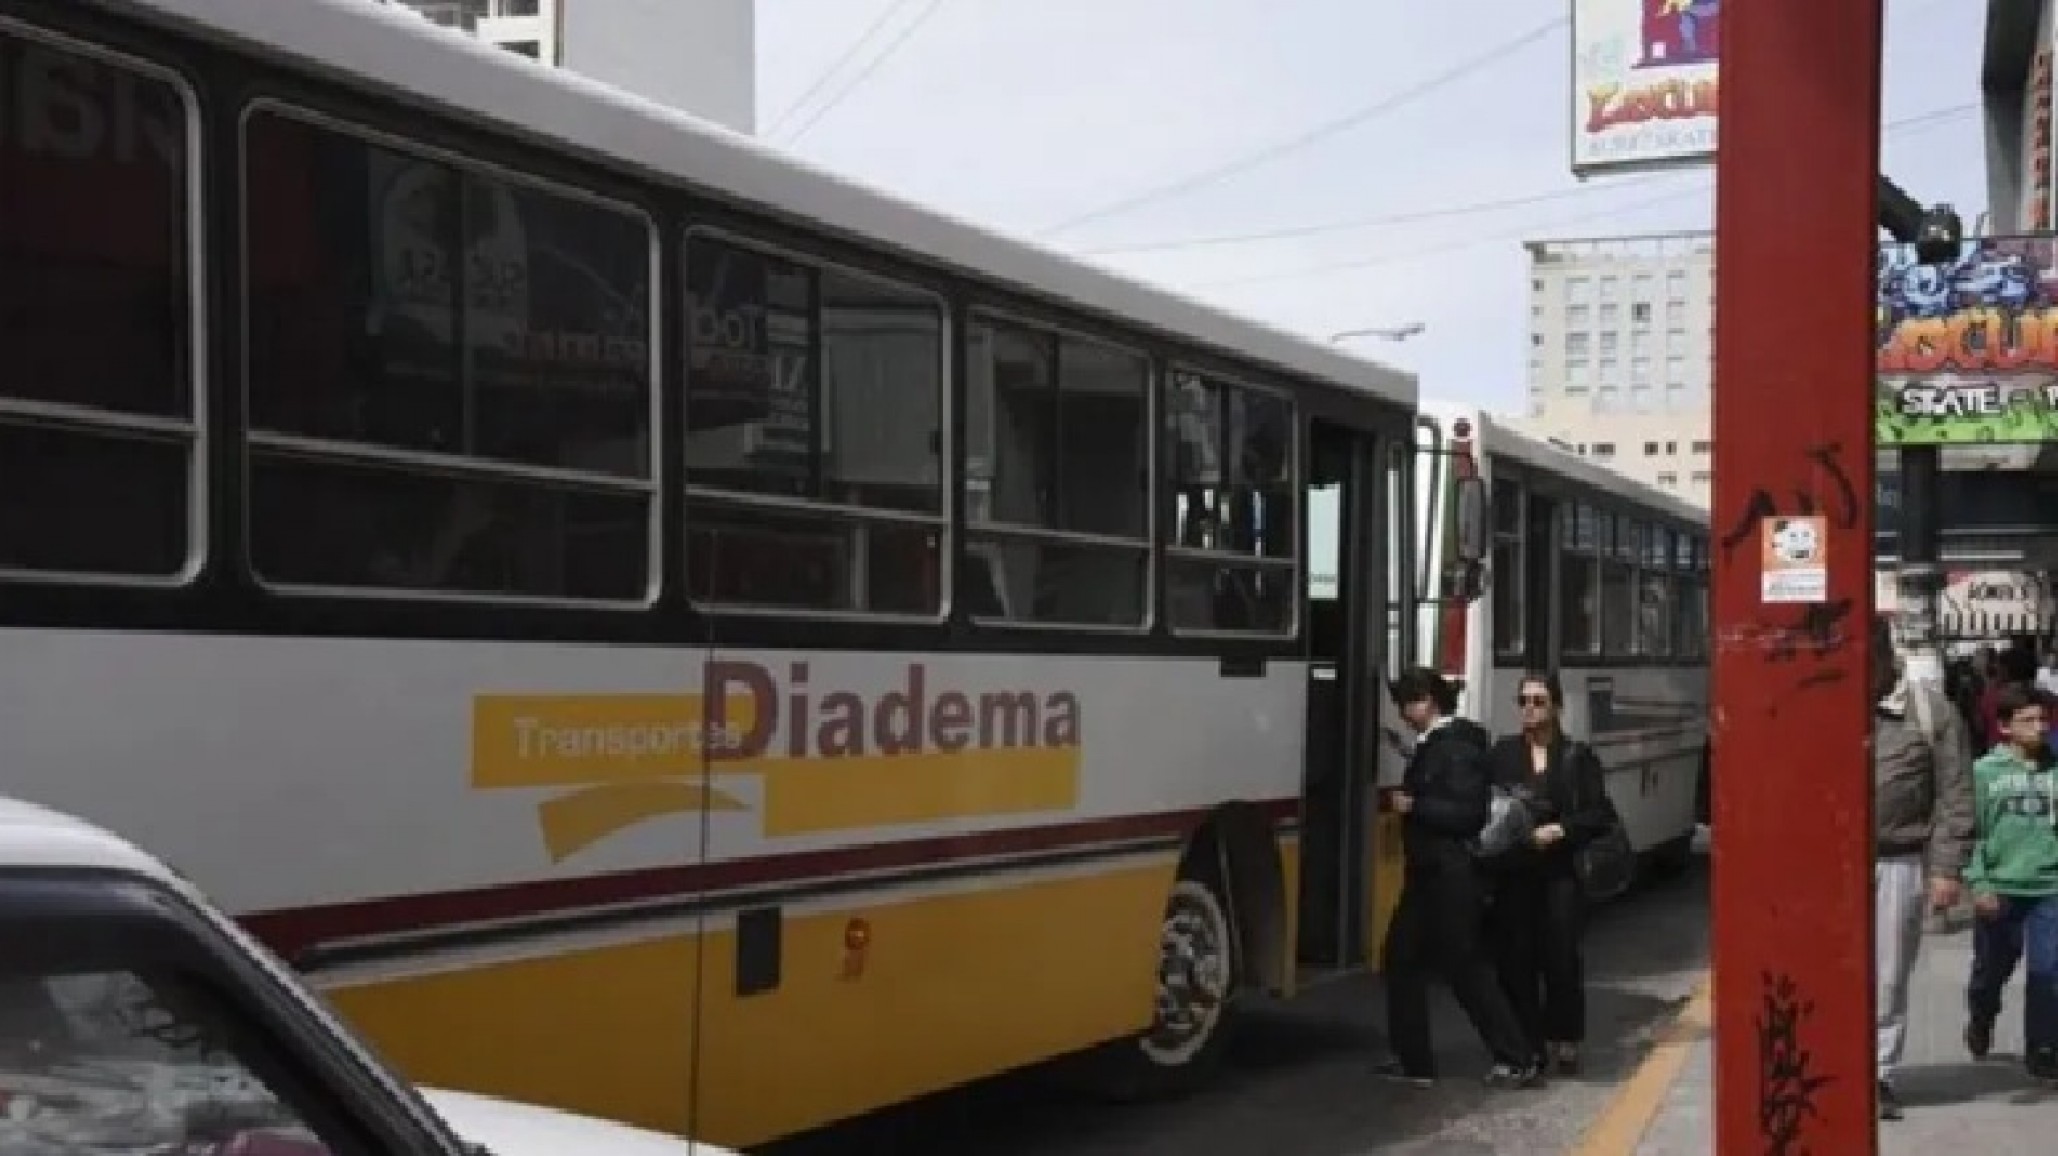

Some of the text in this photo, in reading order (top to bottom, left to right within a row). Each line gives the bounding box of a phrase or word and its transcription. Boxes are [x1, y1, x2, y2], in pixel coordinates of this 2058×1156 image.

[1902, 387, 2001, 417] SKATE
[513, 660, 1081, 760] Transportes Diadema
